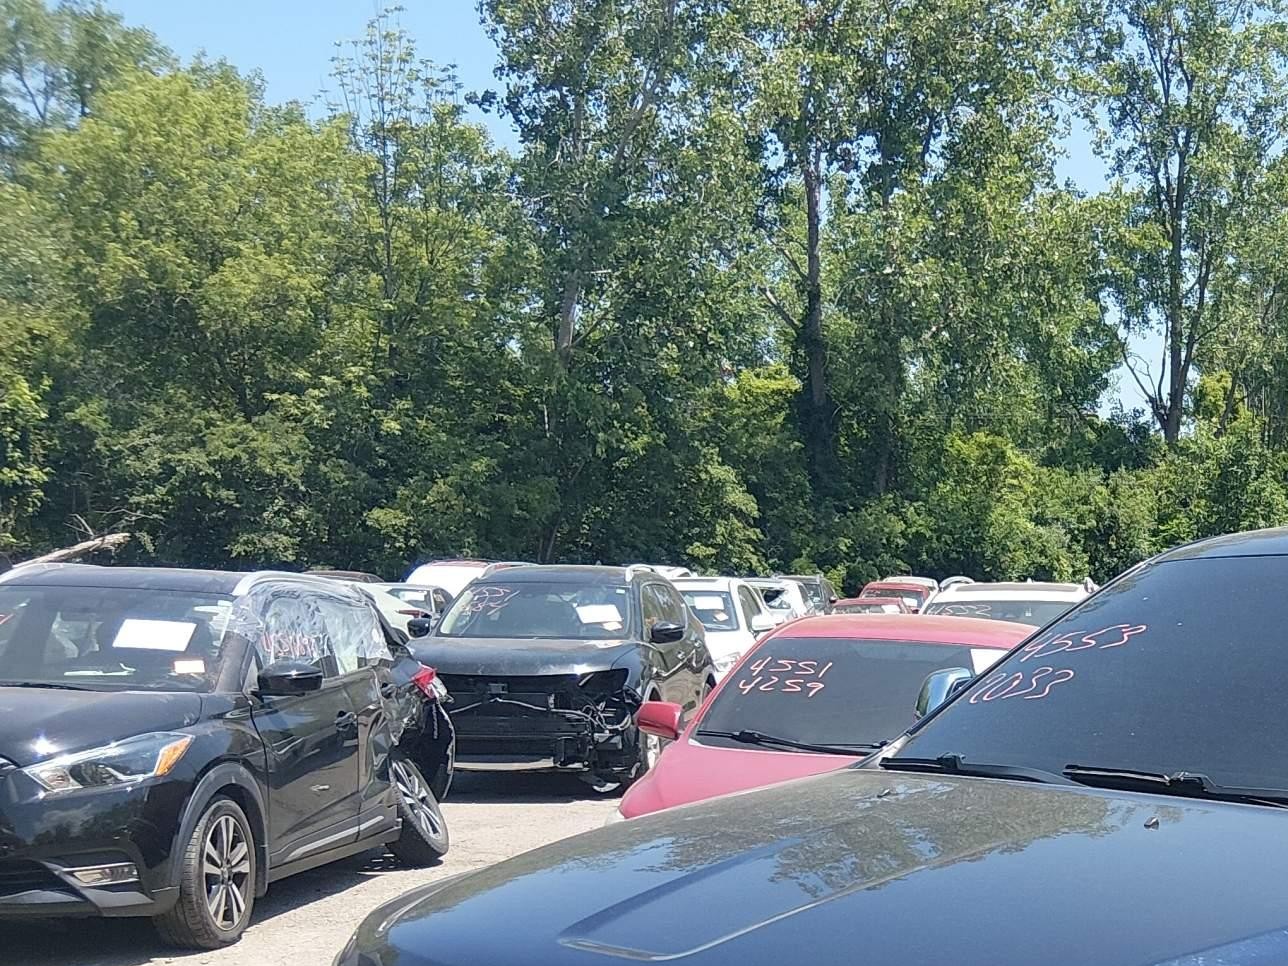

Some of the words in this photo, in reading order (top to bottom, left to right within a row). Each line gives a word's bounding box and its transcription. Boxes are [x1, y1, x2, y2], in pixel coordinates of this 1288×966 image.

[1019, 623, 1148, 663] 4553
[749, 655, 834, 679] 4551
[738, 676, 825, 698] 4259
